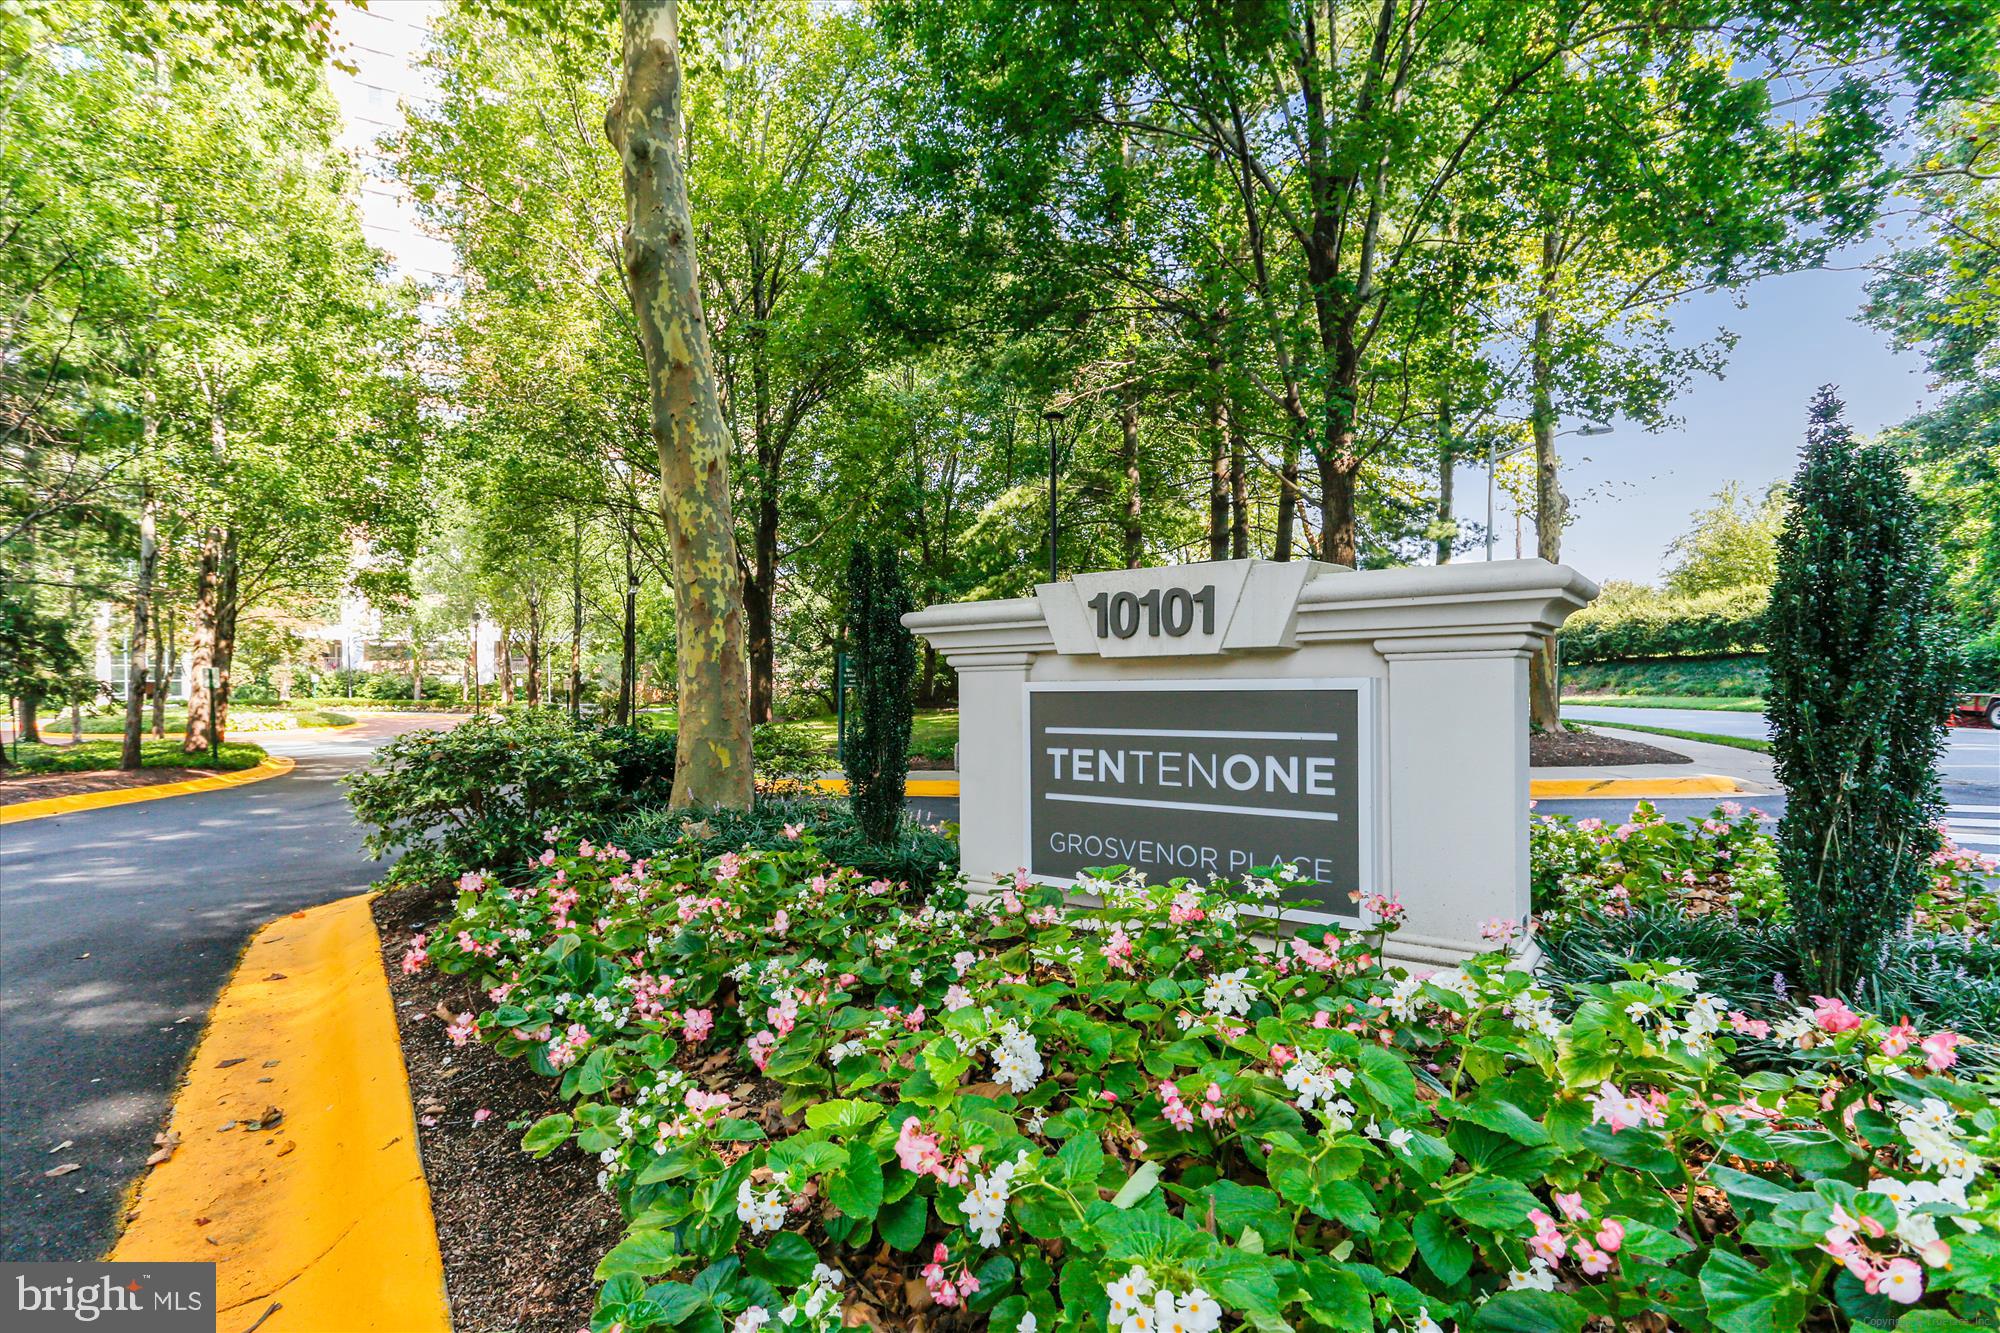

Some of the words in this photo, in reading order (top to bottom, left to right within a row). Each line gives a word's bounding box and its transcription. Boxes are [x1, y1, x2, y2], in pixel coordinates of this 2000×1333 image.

[1087, 584, 1216, 640] 10101
[1046, 747, 1336, 796] TENTENONE
[1049, 831, 1218, 871] GROSVENOR
